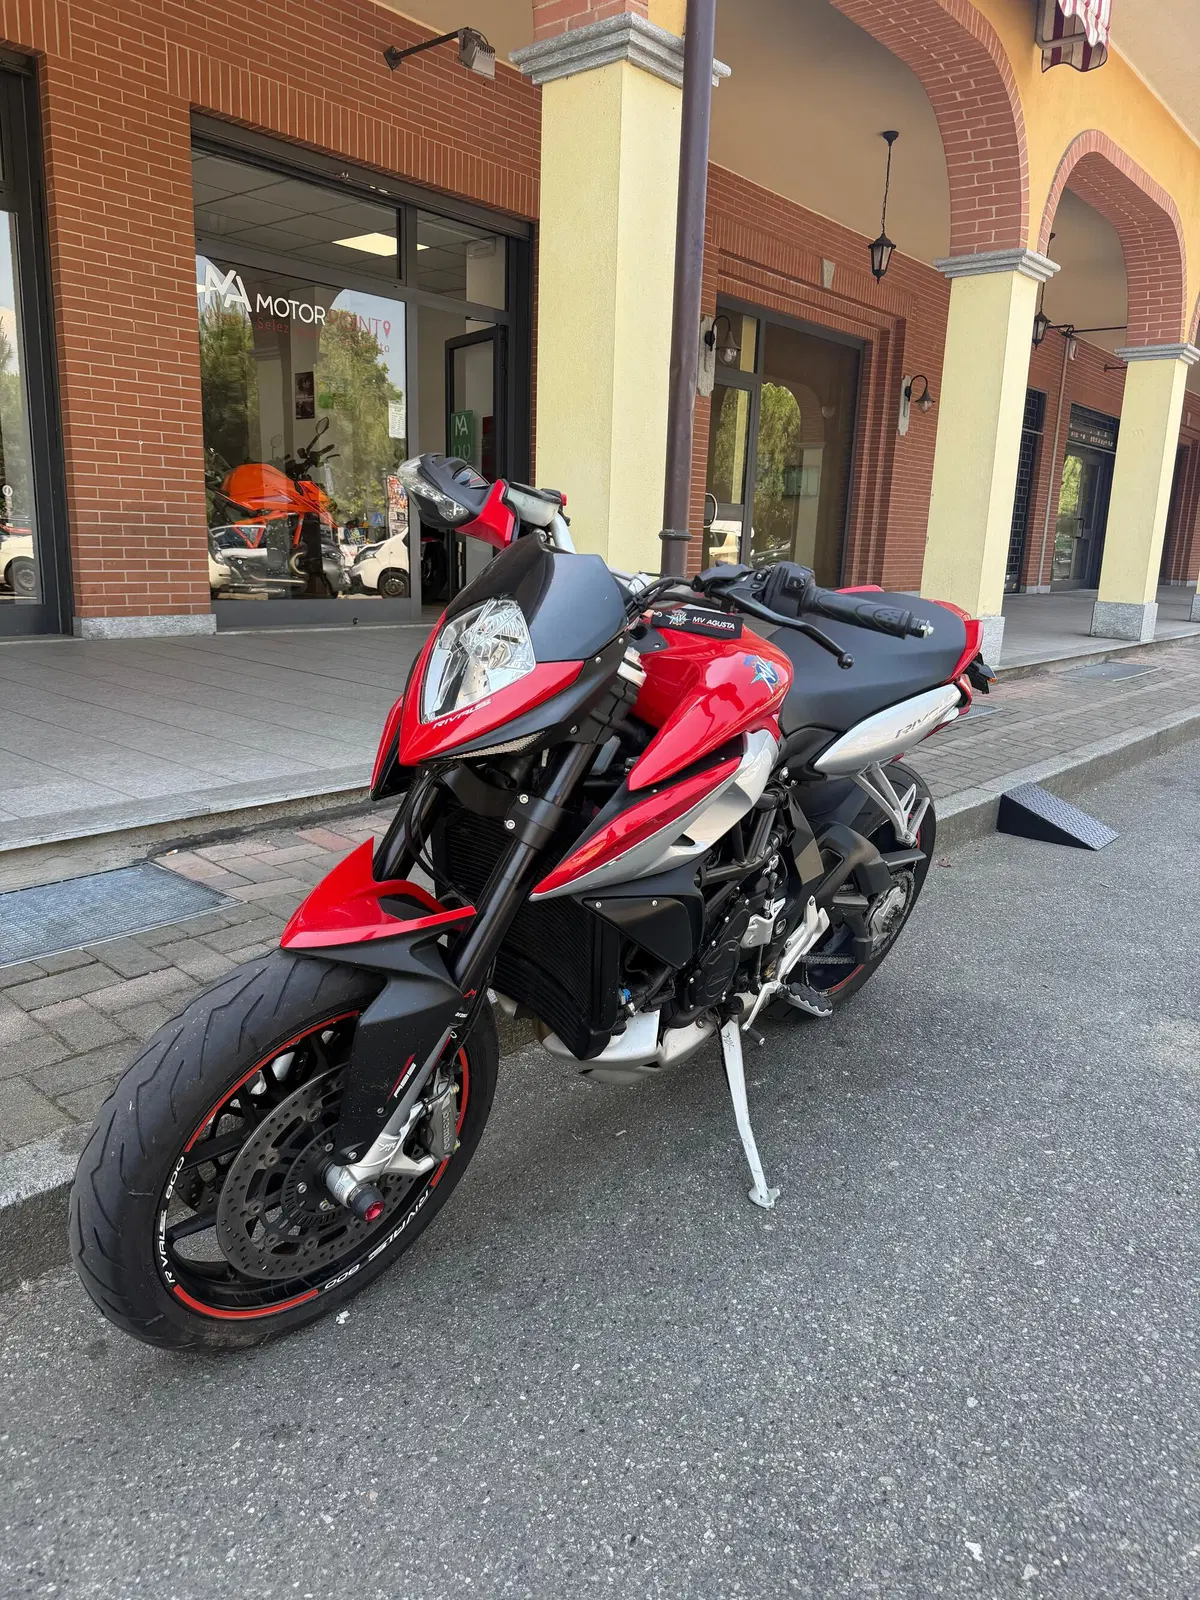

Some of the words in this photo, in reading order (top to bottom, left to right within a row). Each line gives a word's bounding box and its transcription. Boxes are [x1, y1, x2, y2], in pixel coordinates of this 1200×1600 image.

[692, 616, 706, 624] MV
[706, 619, 735, 630] AGUSTA
[441, 1107, 453, 1150] brembo
[165, 1156, 185, 1199] 800
[368, 1189, 429, 1262] RIVALE
[324, 1263, 360, 1290] 800
